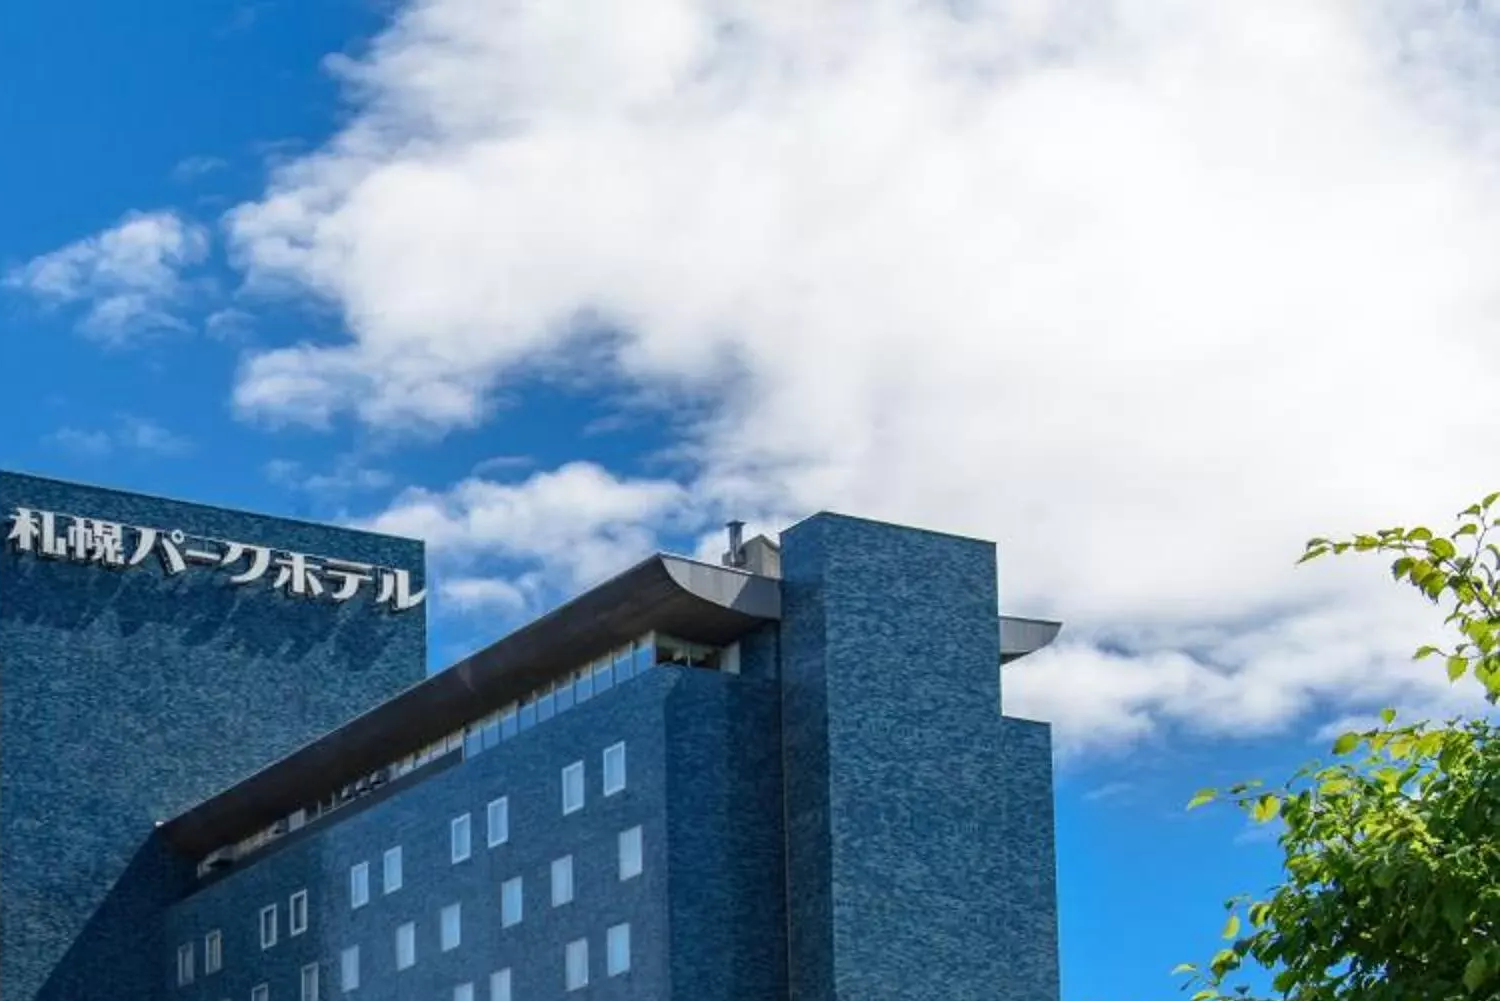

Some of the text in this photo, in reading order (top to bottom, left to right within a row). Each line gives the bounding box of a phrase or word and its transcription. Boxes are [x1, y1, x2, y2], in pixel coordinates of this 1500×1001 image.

[8, 507, 427, 609] 札幌パークホテル
